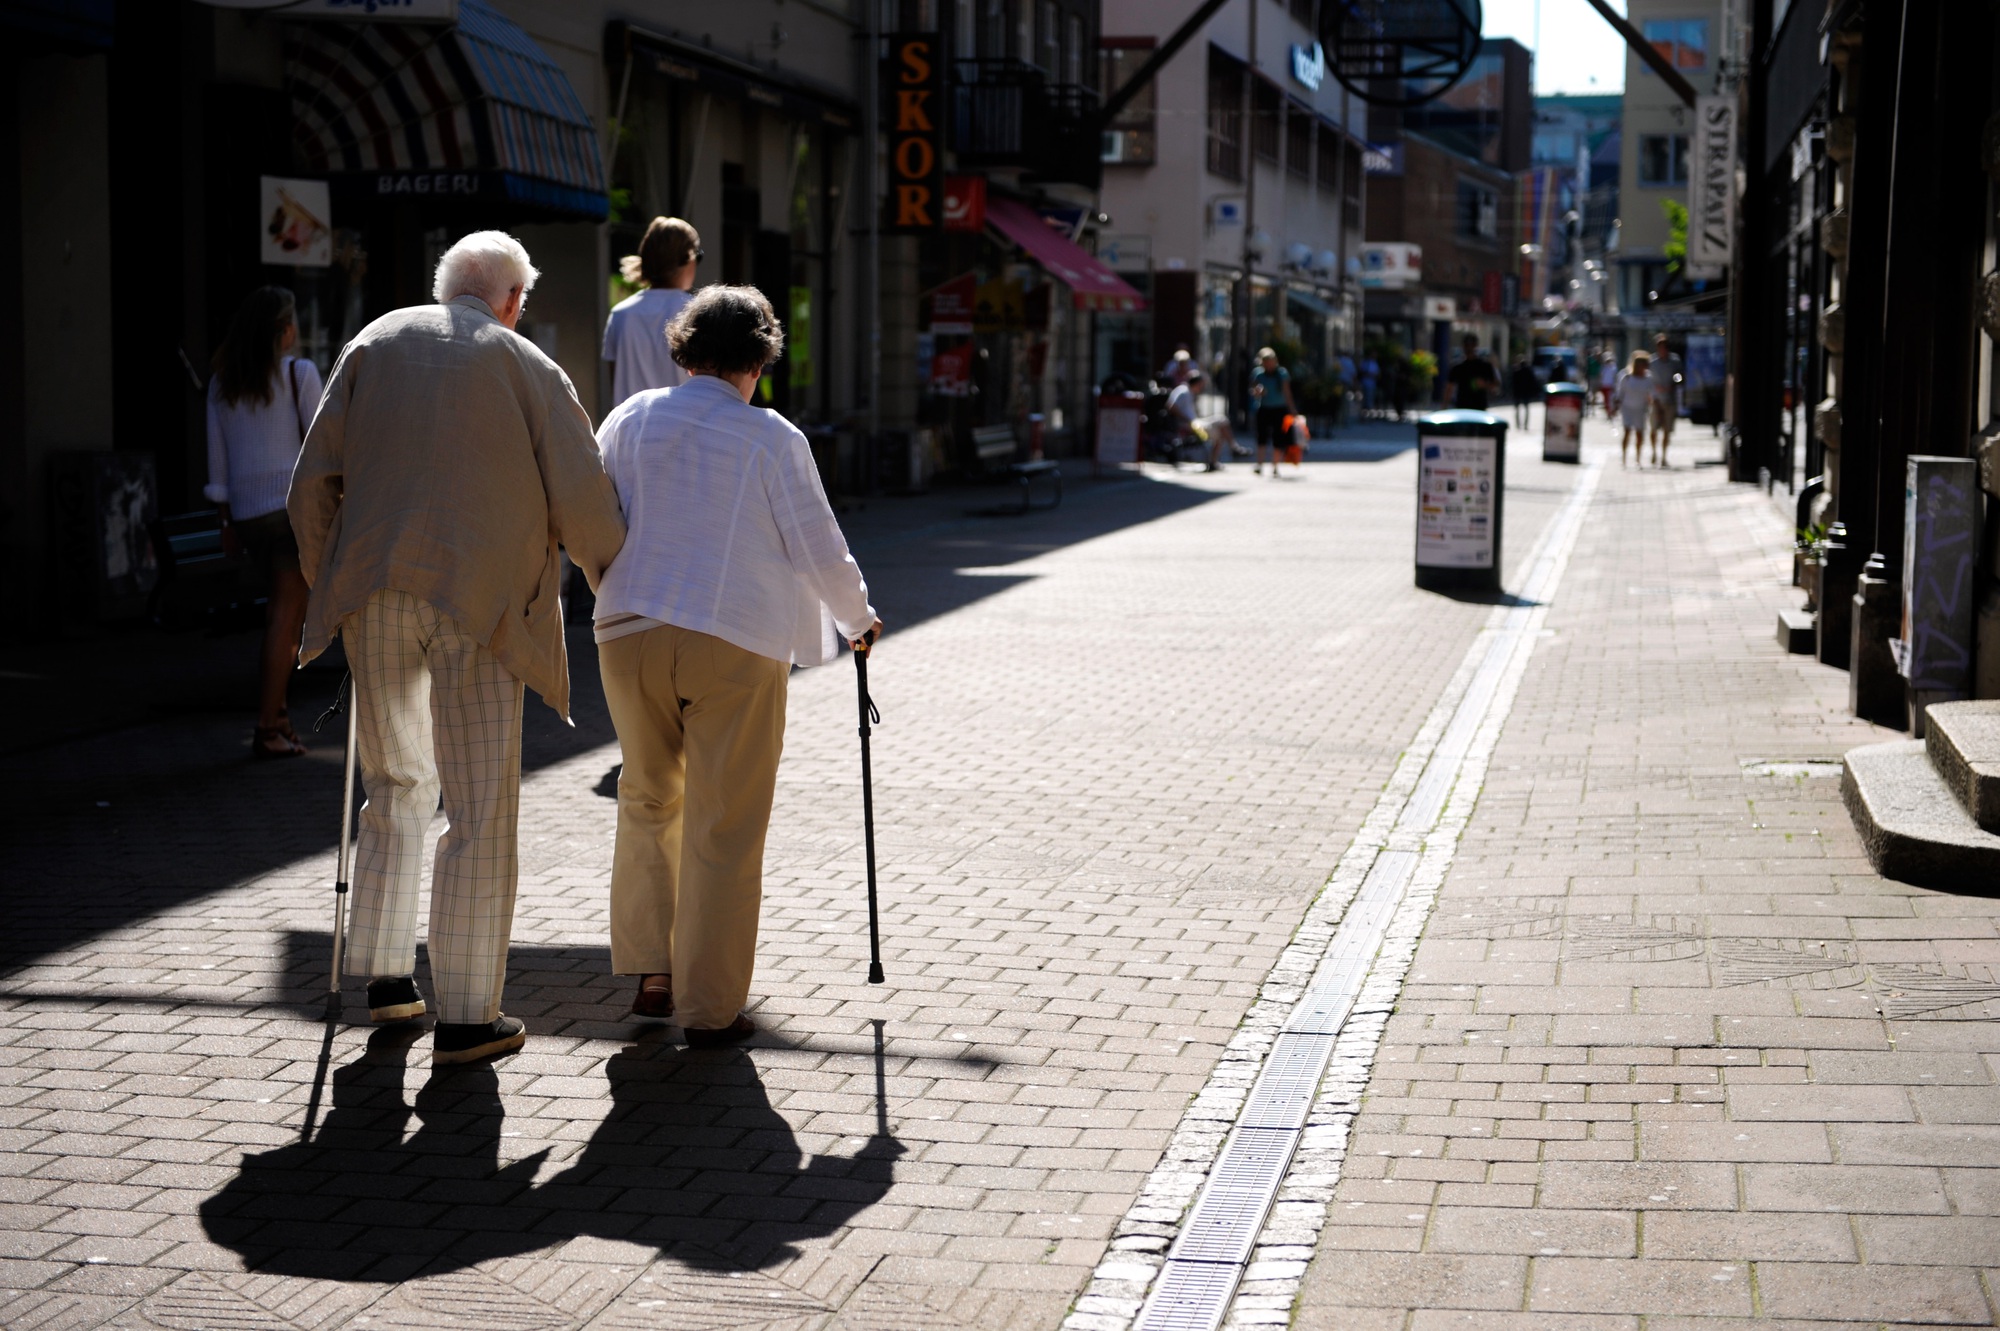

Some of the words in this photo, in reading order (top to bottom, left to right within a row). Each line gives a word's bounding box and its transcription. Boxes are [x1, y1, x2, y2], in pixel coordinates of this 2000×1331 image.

[378, 174, 479, 194] BAGERI
[895, 41, 935, 227] SKOR
[1705, 106, 1732, 253] STRAPATZ
